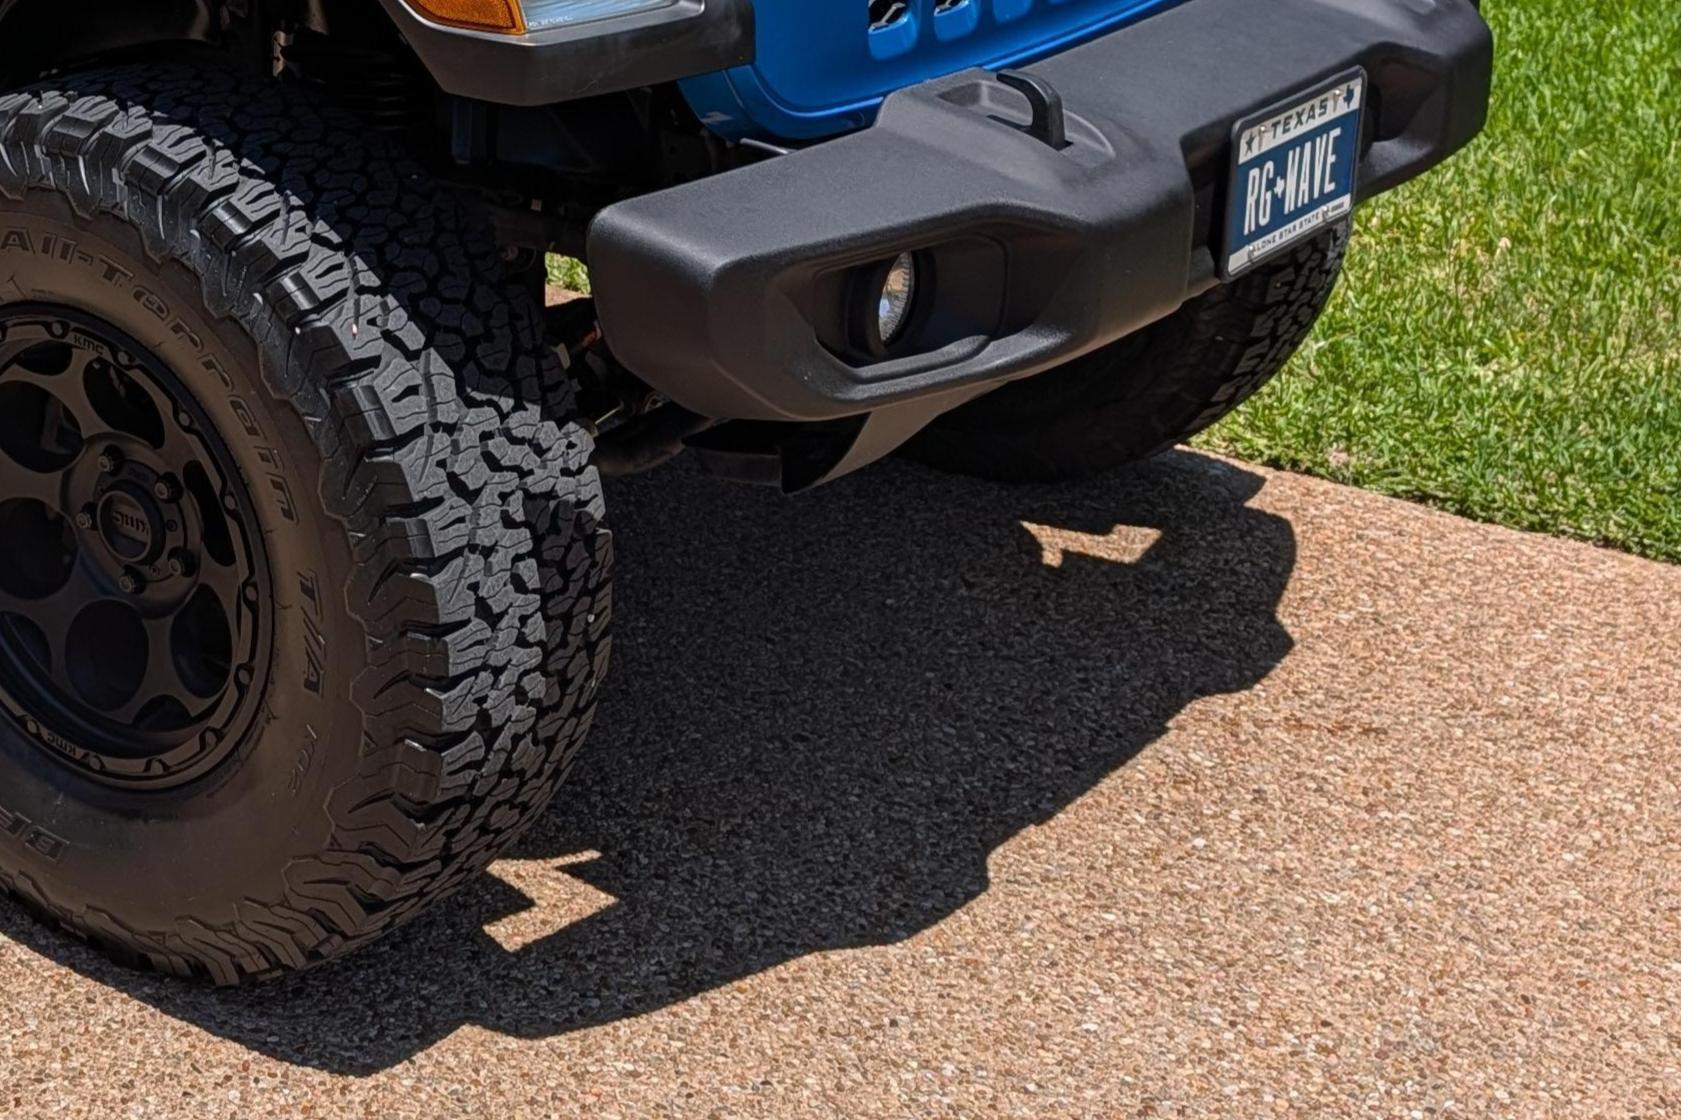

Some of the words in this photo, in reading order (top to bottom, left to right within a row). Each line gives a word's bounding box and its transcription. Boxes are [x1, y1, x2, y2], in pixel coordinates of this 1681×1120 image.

[1271, 96, 1329, 140] TEXAS
[1243, 160, 1275, 236] RG
[1284, 127, 1342, 215] WAVE
[1279, 224, 1298, 241] STAR
[1299, 211, 1320, 229] STATE
[0, 227, 300, 525] All-Terrain
